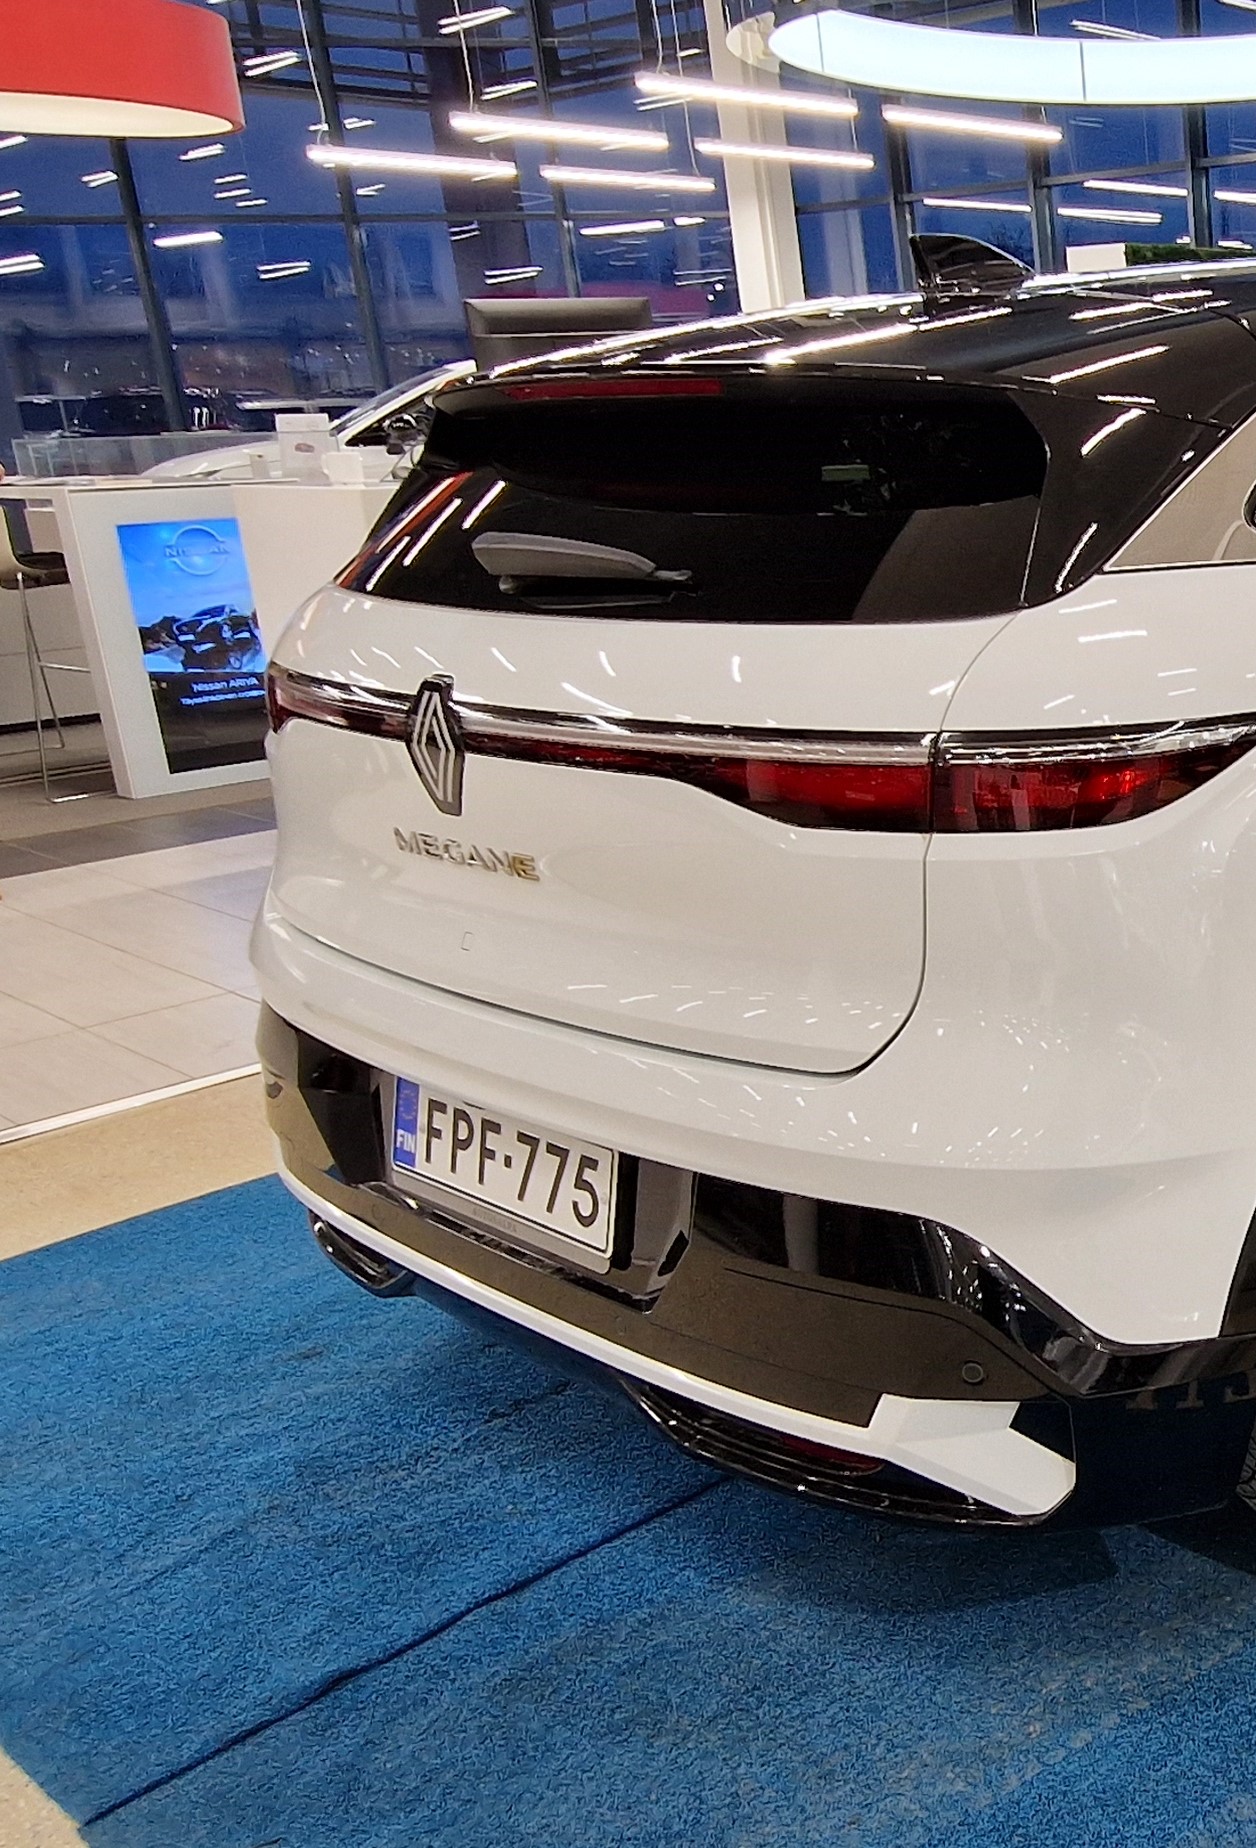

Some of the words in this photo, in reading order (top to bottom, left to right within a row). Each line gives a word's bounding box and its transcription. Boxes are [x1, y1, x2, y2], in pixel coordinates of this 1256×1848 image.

[165, 543, 230, 557] NIAN
[393, 827, 540, 882] MEGANE
[396, 1129, 416, 1153] FIN
[425, 1097, 600, 1228] FPF-775
